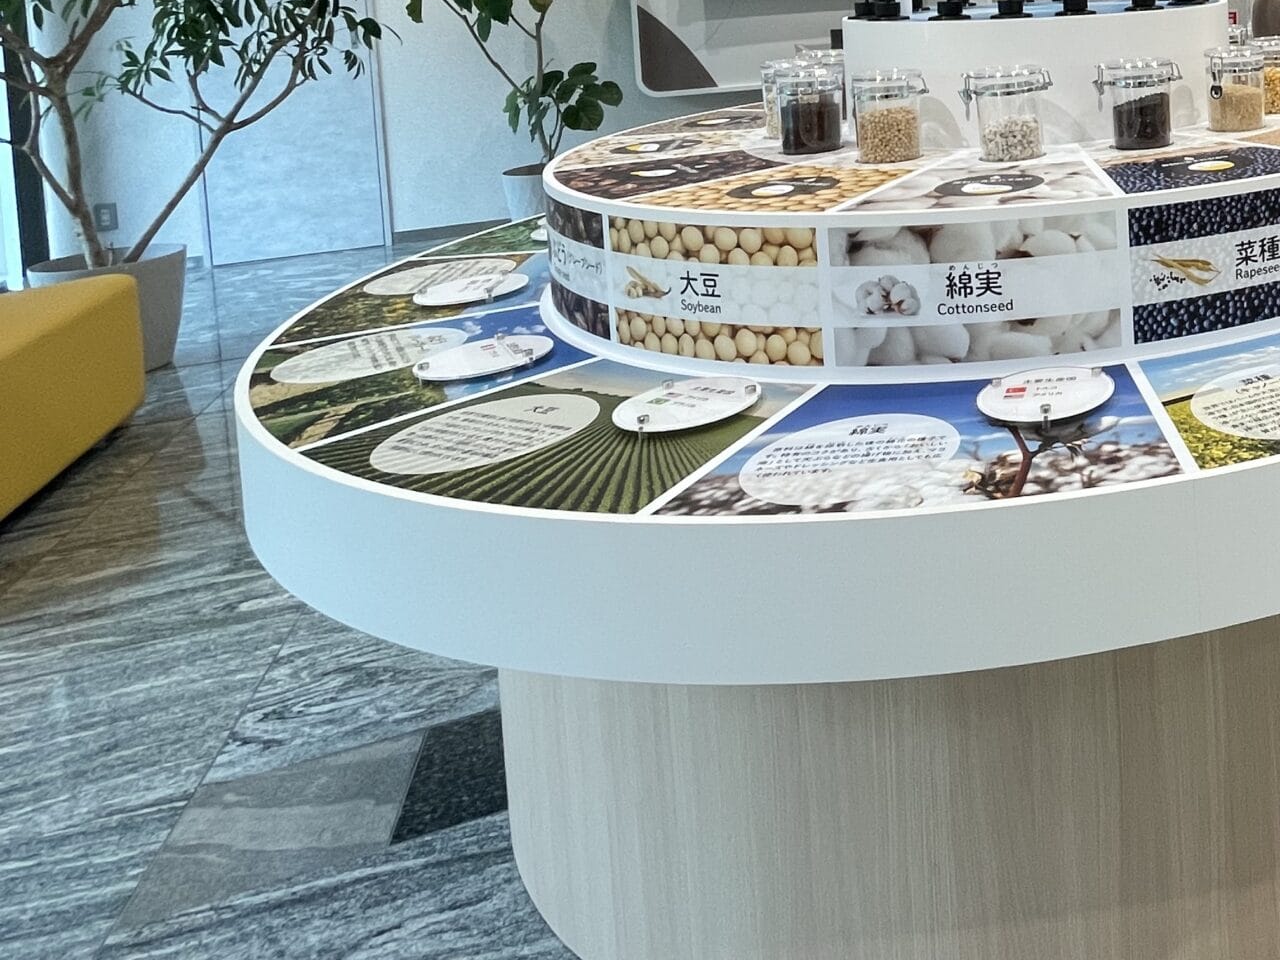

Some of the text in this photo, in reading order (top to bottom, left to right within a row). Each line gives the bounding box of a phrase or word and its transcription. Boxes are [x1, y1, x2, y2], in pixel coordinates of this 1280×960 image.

[679, 270, 722, 298] 大豆
[945, 269, 1003, 299] 綿実
[680, 299, 722, 314] Soybean
[937, 299, 1014, 315] Cottonseed
